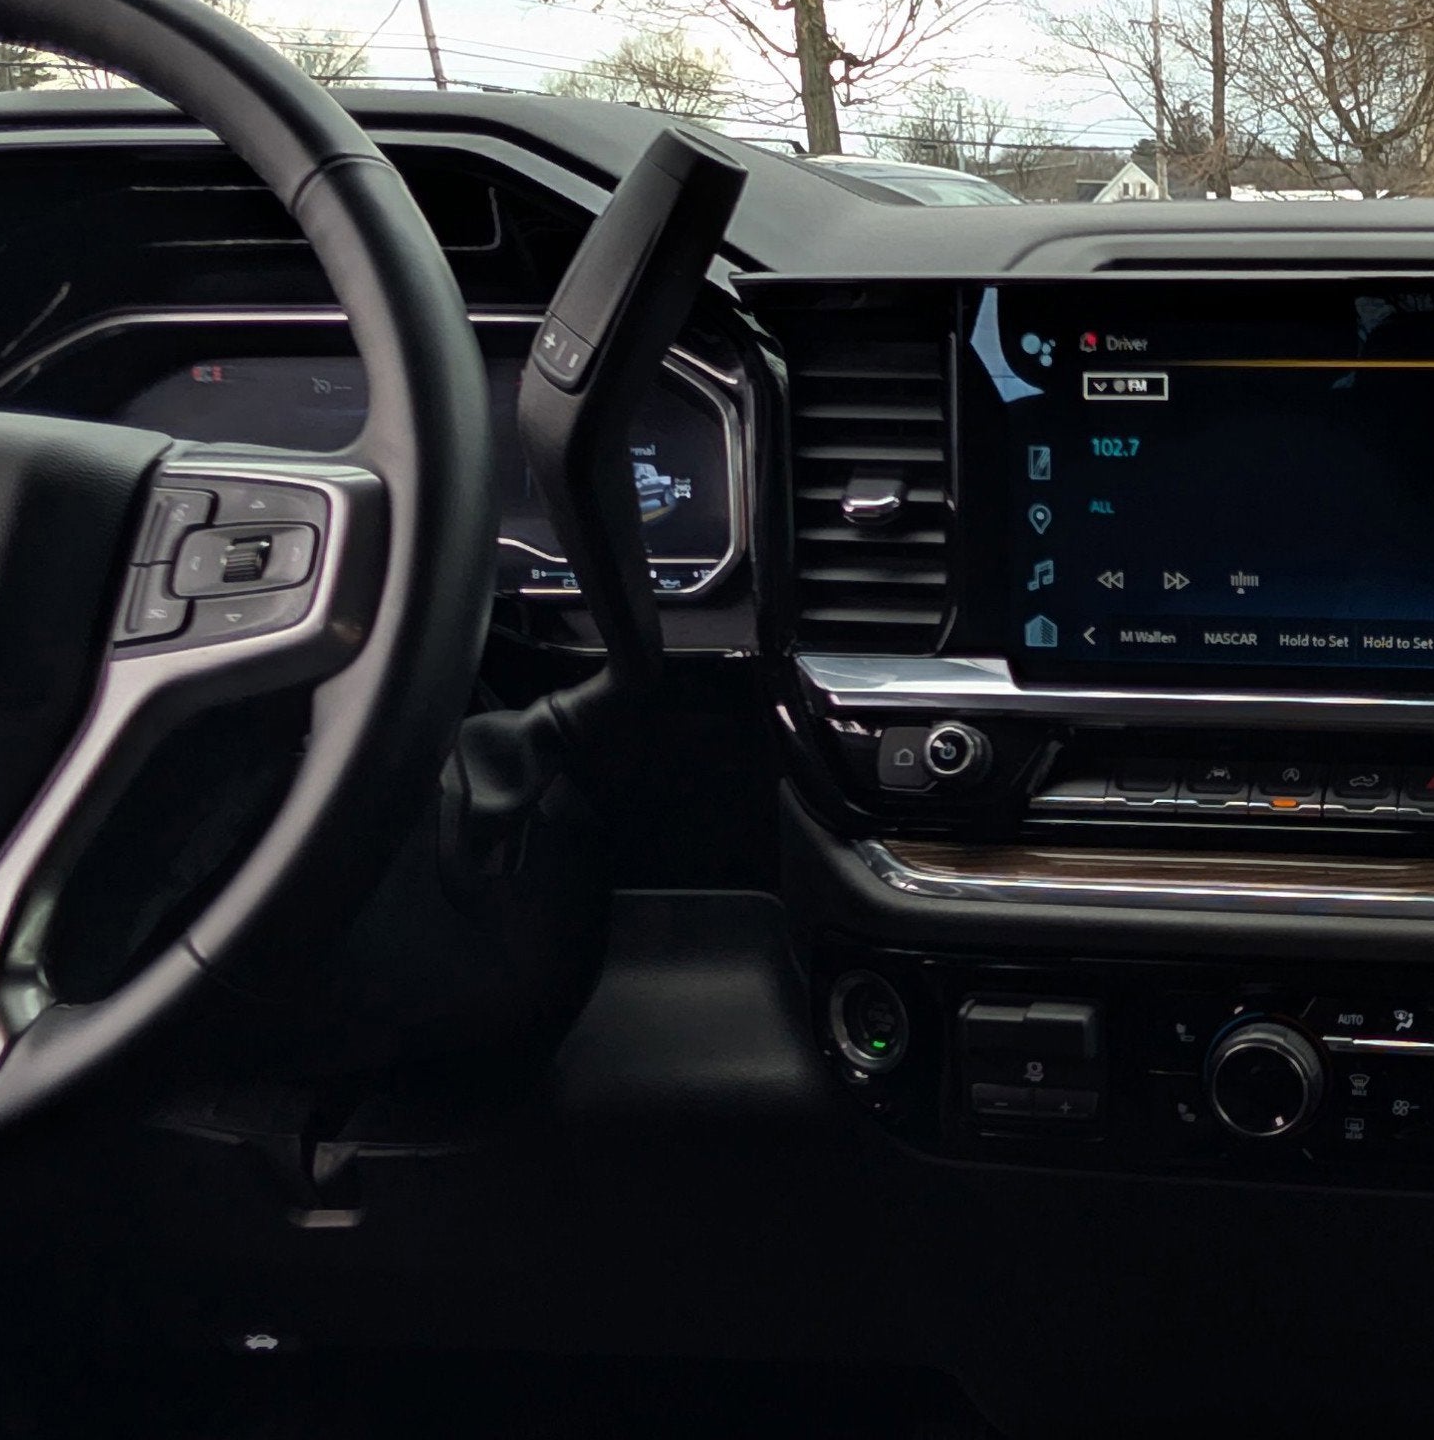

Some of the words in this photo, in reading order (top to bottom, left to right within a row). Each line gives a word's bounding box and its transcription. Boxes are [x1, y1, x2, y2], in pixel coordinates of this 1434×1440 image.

[1105, 335, 1149, 352] Driver
[1091, 437, 1141, 458] 102.7
[1120, 631, 1134, 643] M
[1204, 632, 1258, 646] NASCAR
[1279, 634, 1309, 648] Hold
[1312, 636, 1327, 648] to
[1328, 635, 1349, 648] Set
[1363, 635, 1394, 650] Hold
[1396, 637, 1411, 650] to
[1413, 637, 1434, 650] Set
[1337, 1013, 1364, 1026] AUTO
